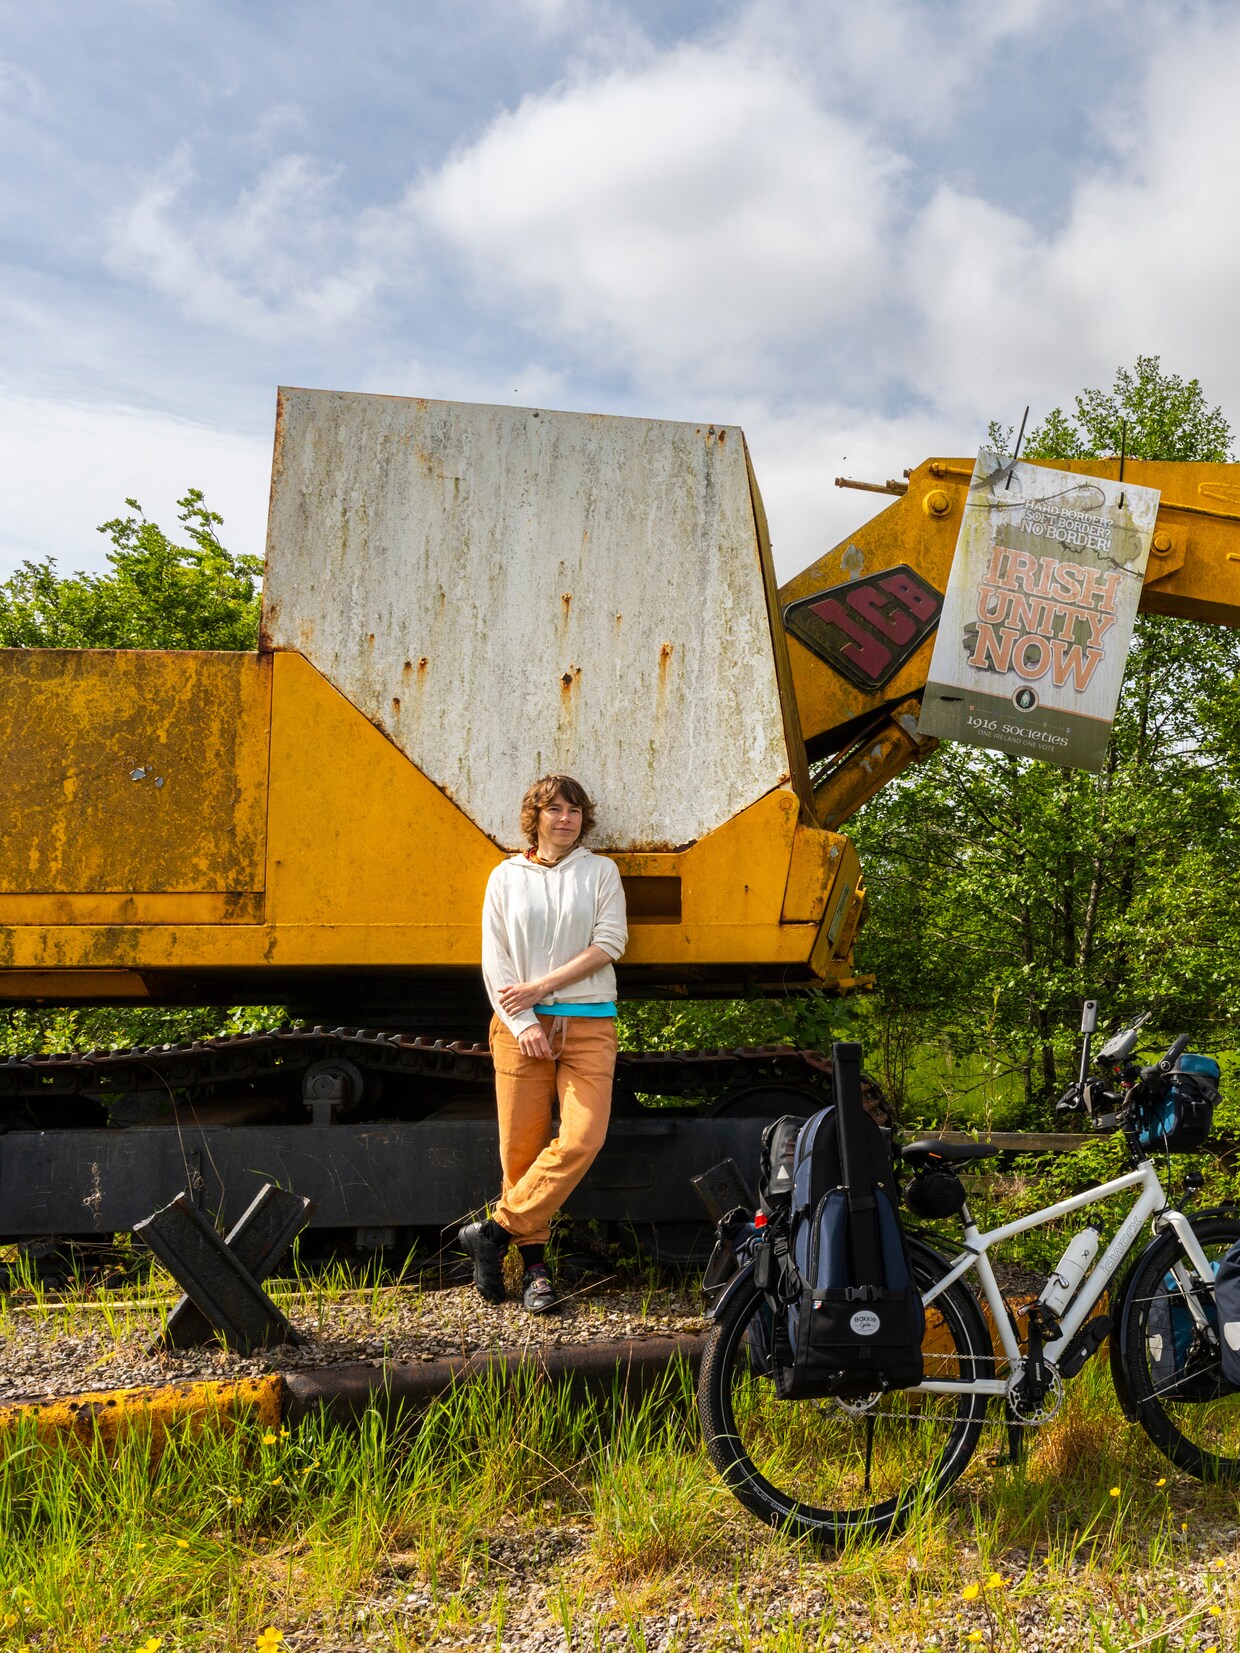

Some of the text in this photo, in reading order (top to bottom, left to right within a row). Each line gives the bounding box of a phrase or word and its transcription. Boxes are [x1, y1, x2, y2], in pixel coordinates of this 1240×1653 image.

[1019, 519, 1112, 552] NO BORDER!
[1025, 500, 1114, 529] HARD BORDER?
[1025, 510, 1111, 539] SOFT BORDER?
[983, 545, 1122, 613] IRISH
[808, 574, 938, 679] JCB
[978, 584, 1117, 648] UNITY
[968, 621, 1105, 692] NOW
[966, 715, 998, 731] 1916
[977, 729, 1055, 752] ONE IRELAND ONE VOTE
[1100, 1215, 1142, 1276] idworx
